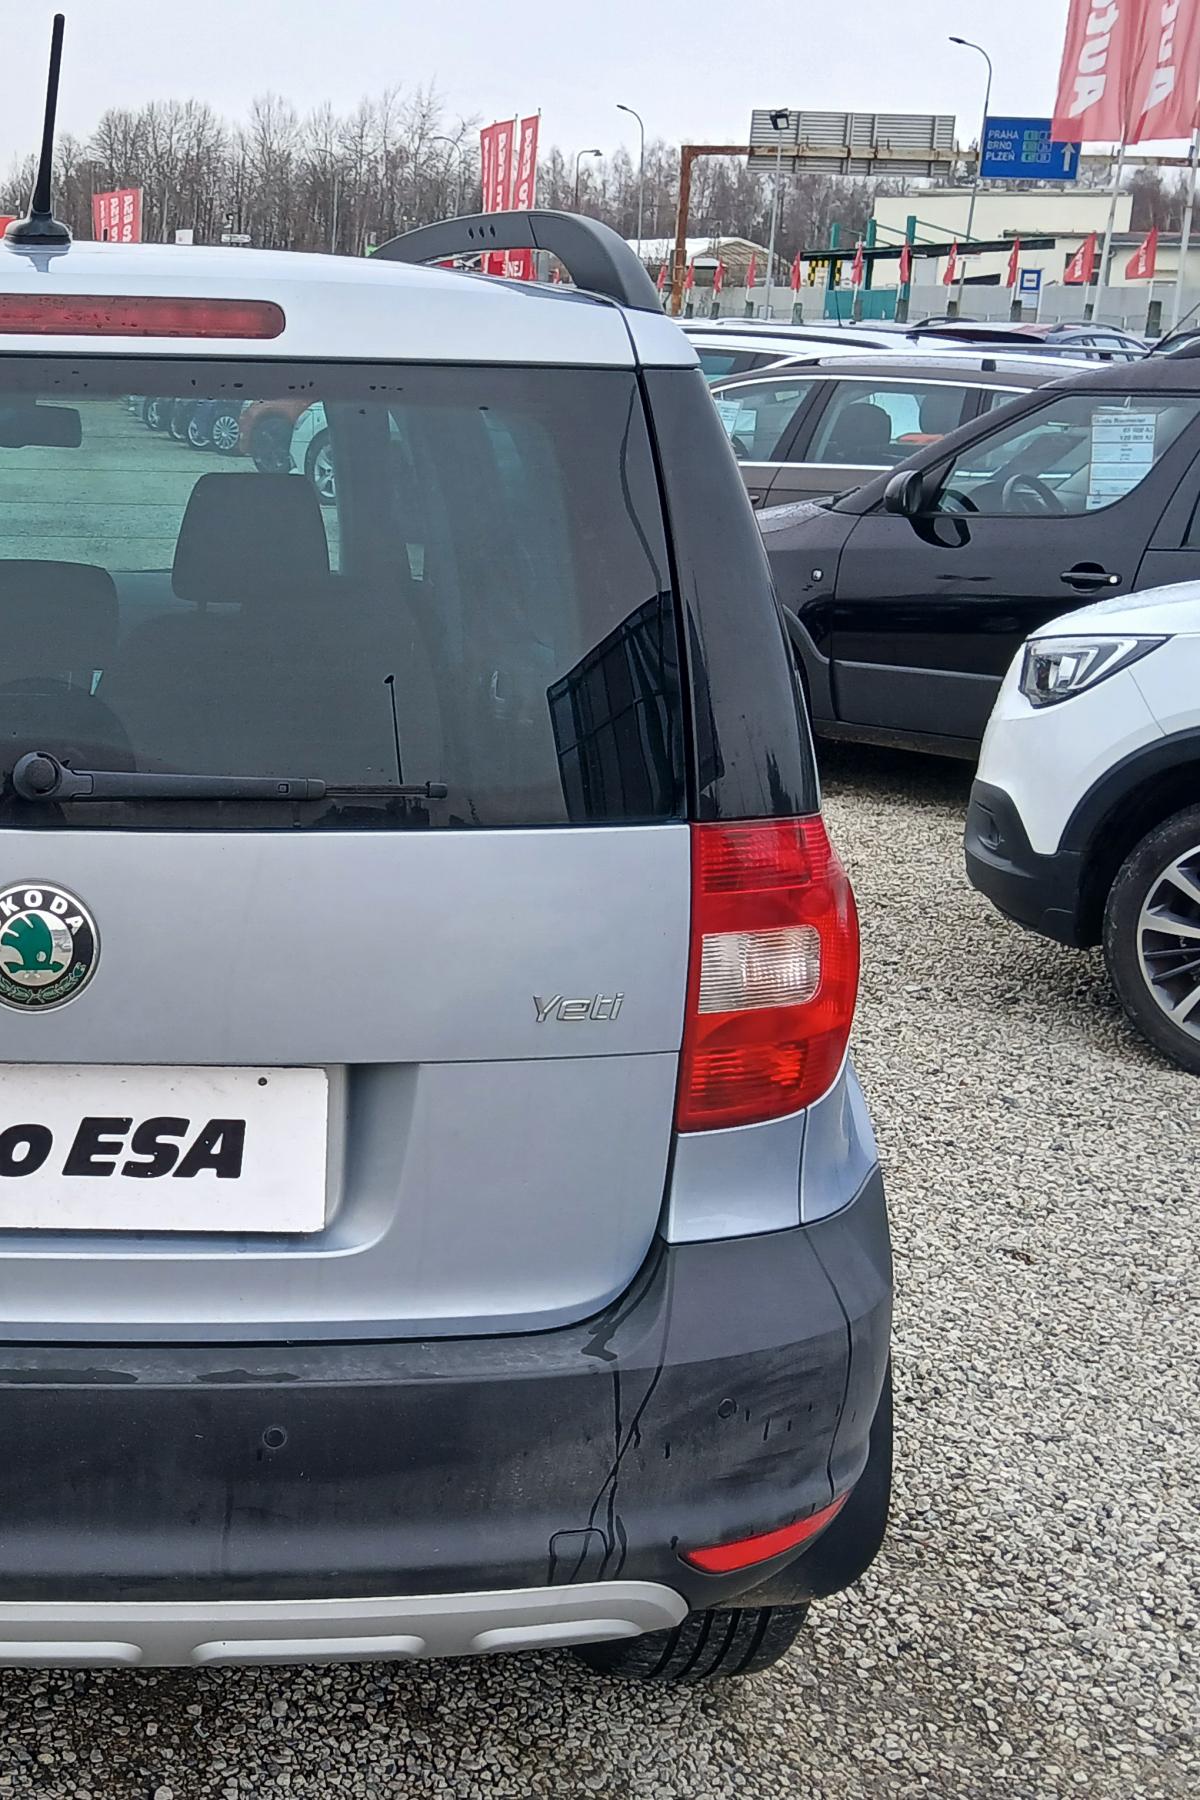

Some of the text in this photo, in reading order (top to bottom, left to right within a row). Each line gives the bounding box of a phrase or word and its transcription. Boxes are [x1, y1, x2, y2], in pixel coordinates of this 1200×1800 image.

[986, 140, 1013, 150] BRNO
[987, 130, 1020, 140] PRAHA
[532, 991, 625, 1024] Yeti
[62, 1116, 247, 1179] ESA
